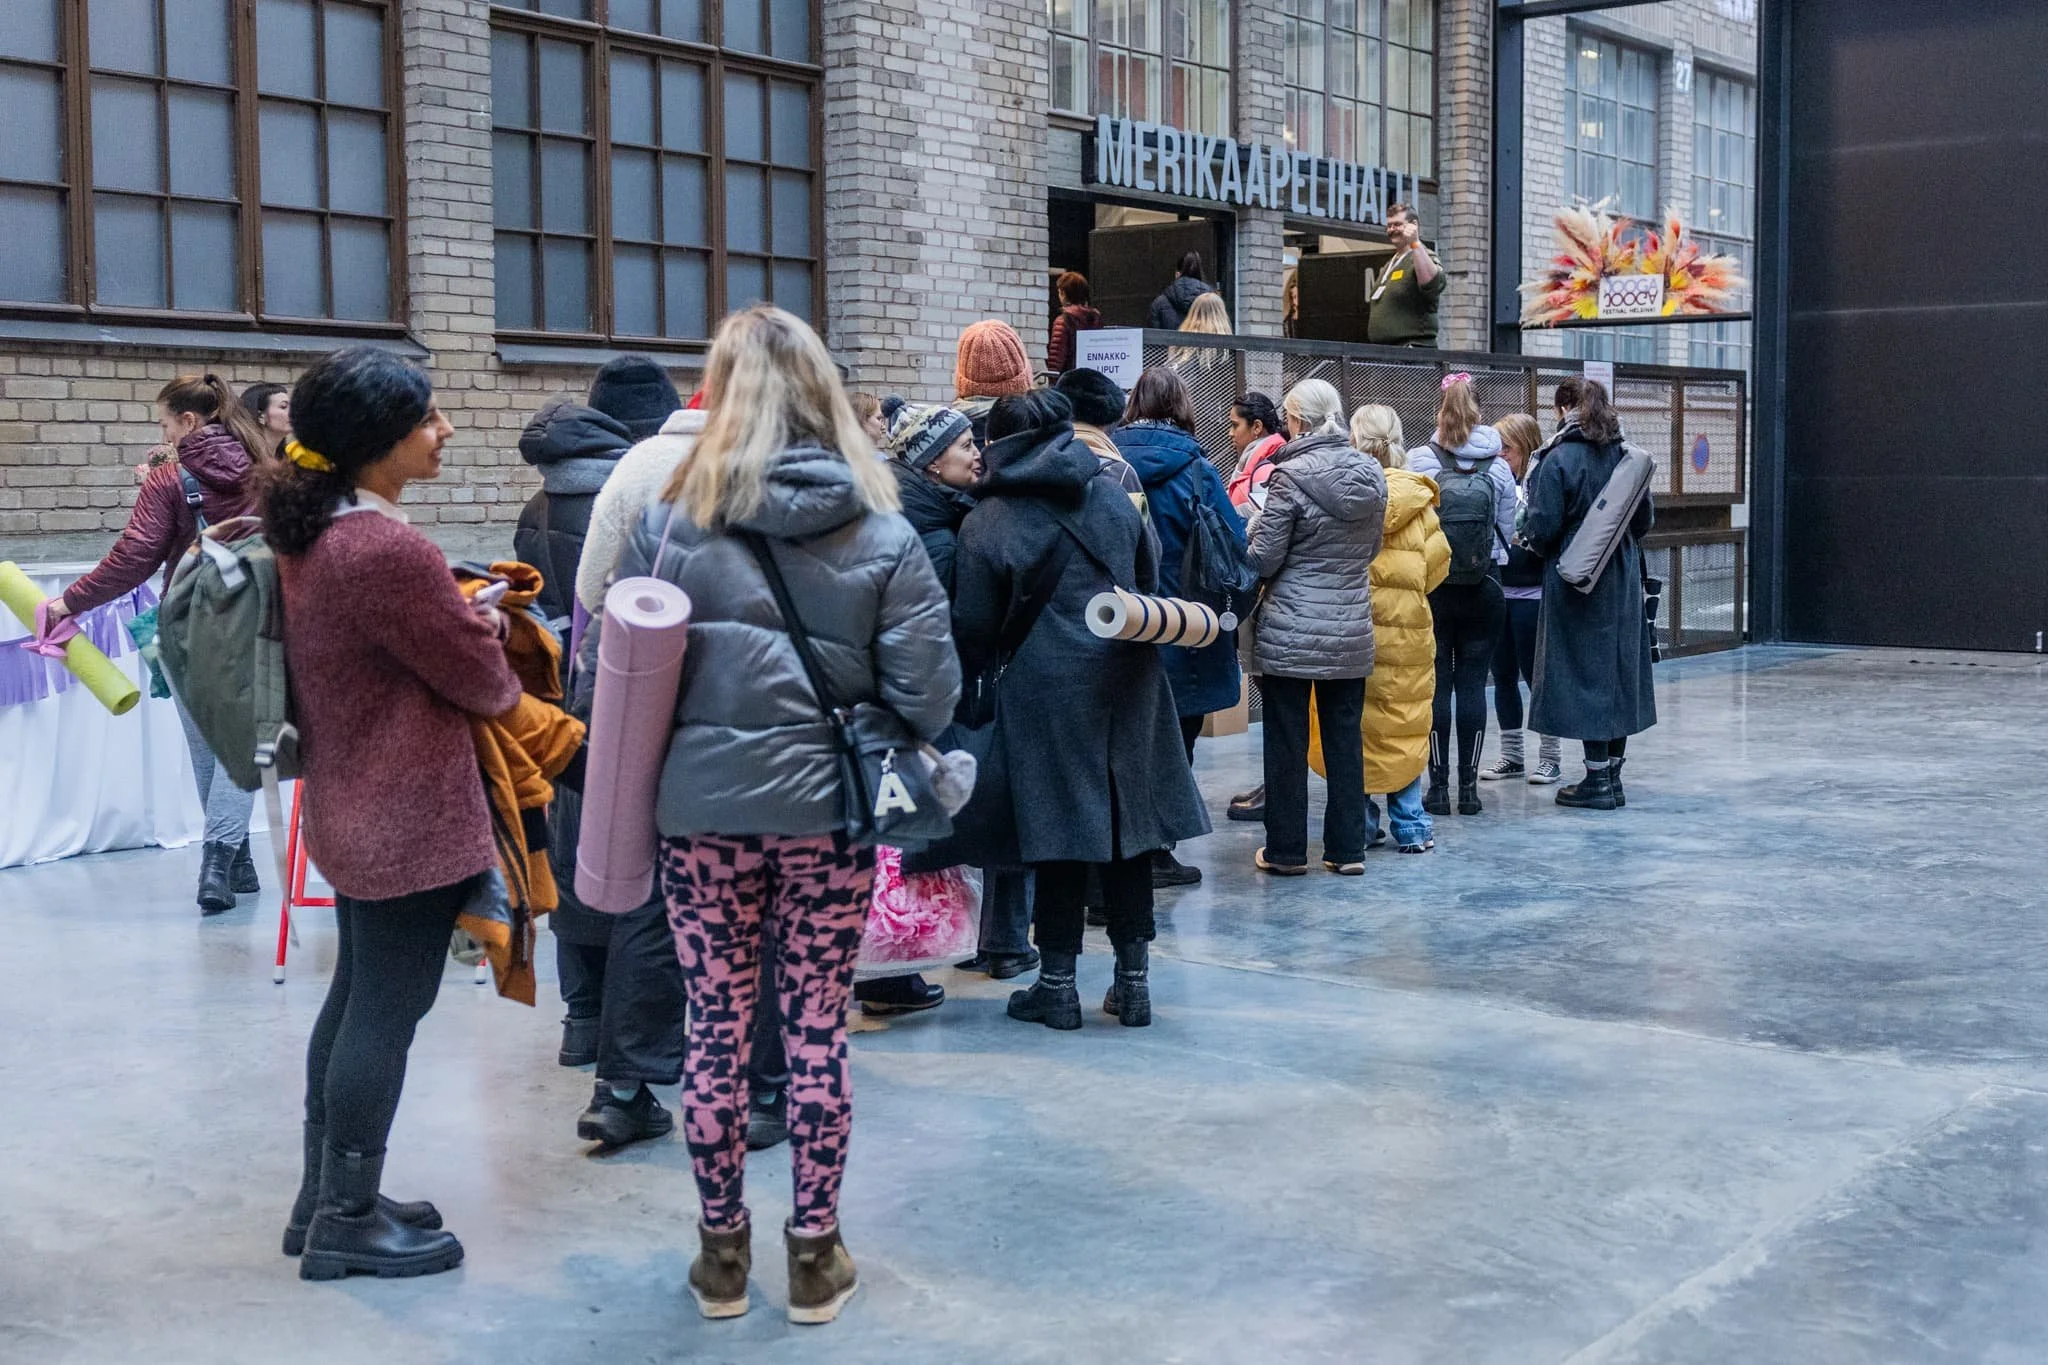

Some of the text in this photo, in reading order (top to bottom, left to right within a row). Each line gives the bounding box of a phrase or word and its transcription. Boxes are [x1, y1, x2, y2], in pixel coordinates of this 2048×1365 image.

[1675, 60, 1691, 93] 27
[1087, 352, 1130, 361] ENNAKKO-
[874, 772, 918, 817] A
